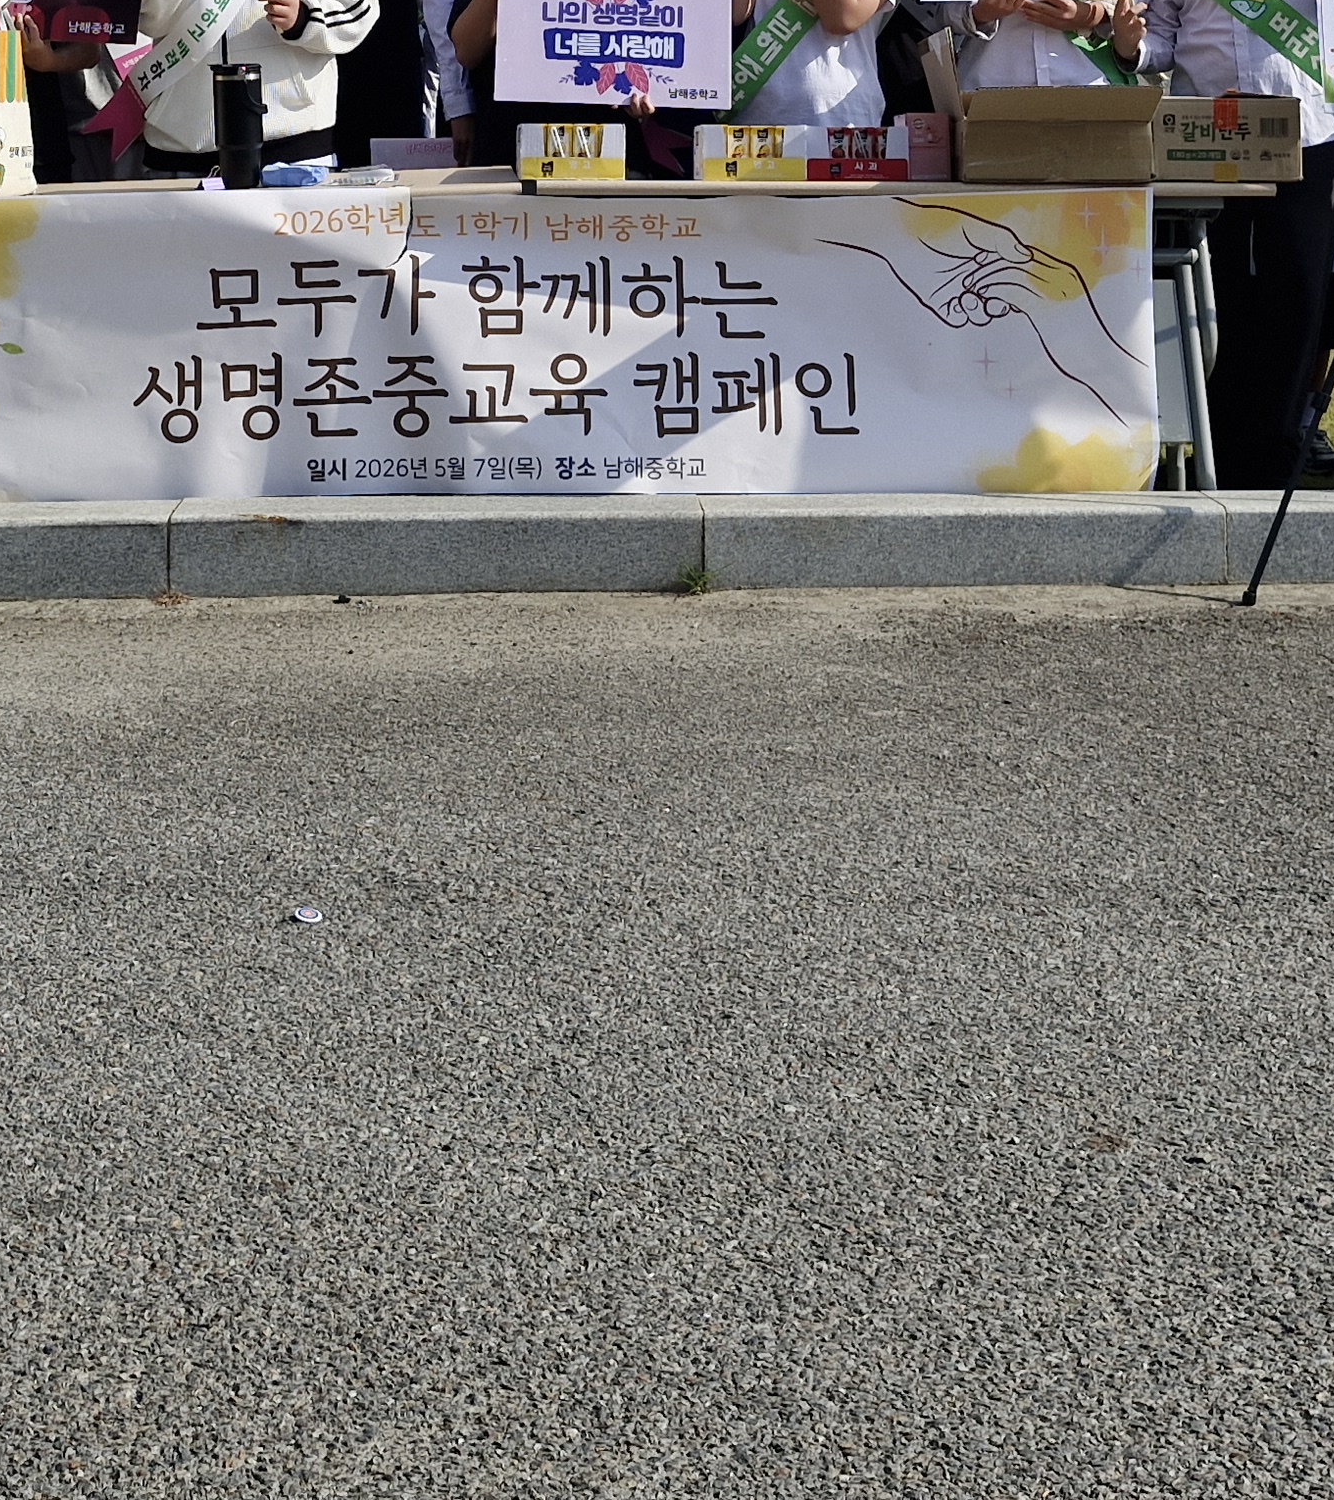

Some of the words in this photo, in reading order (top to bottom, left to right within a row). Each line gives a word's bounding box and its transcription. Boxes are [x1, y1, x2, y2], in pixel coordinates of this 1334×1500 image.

[67, 19, 126, 35] 남해중학교
[541, 0, 588, 25] 나의
[591, 2, 684, 28] 생명같이
[554, 30, 601, 57] 너를
[603, 32, 676, 61] 사랑해
[668, 86, 719, 100] 남해중학교
[272, 202, 443, 242] 2026학년도
[455, 210, 531, 243] 1학기
[544, 212, 704, 243] 남해중학교
[194, 254, 437, 338] 모두가
[461, 254, 779, 340] 함께하는
[132, 351, 609, 444] 생명존중교육
[632, 351, 861, 439] 캠페인
[306, 458, 348, 482] 일시
[354, 457, 429, 482] 2026년
[434, 456, 467, 481] 5월
[473, 456, 543, 481] 7일(목)
[553, 455, 597, 481] 장소
[603, 456, 708, 481] 남해중학교
